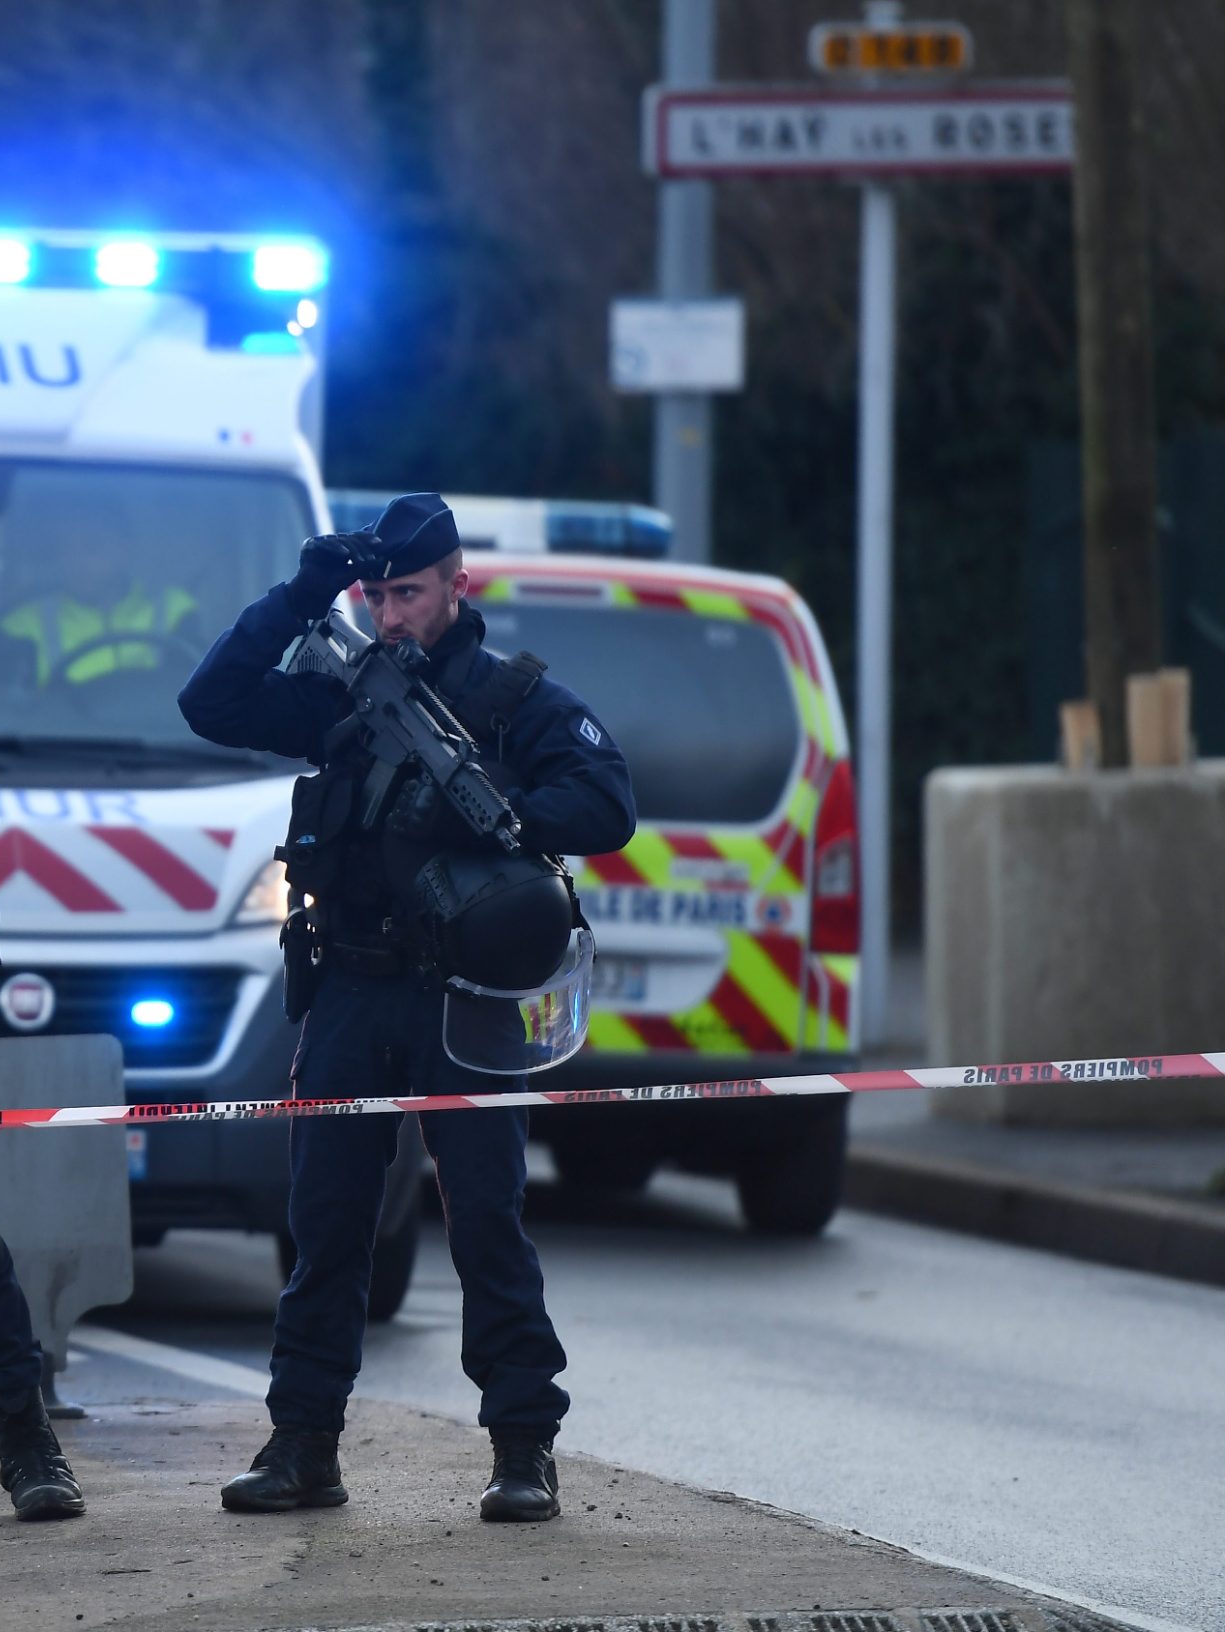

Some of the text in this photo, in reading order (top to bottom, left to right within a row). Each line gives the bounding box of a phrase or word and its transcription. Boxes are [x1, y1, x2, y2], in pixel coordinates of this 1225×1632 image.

[932, 112, 1059, 153] ROSE
[630, 889, 665, 922] DE
[672, 891, 747, 925] PARIS
